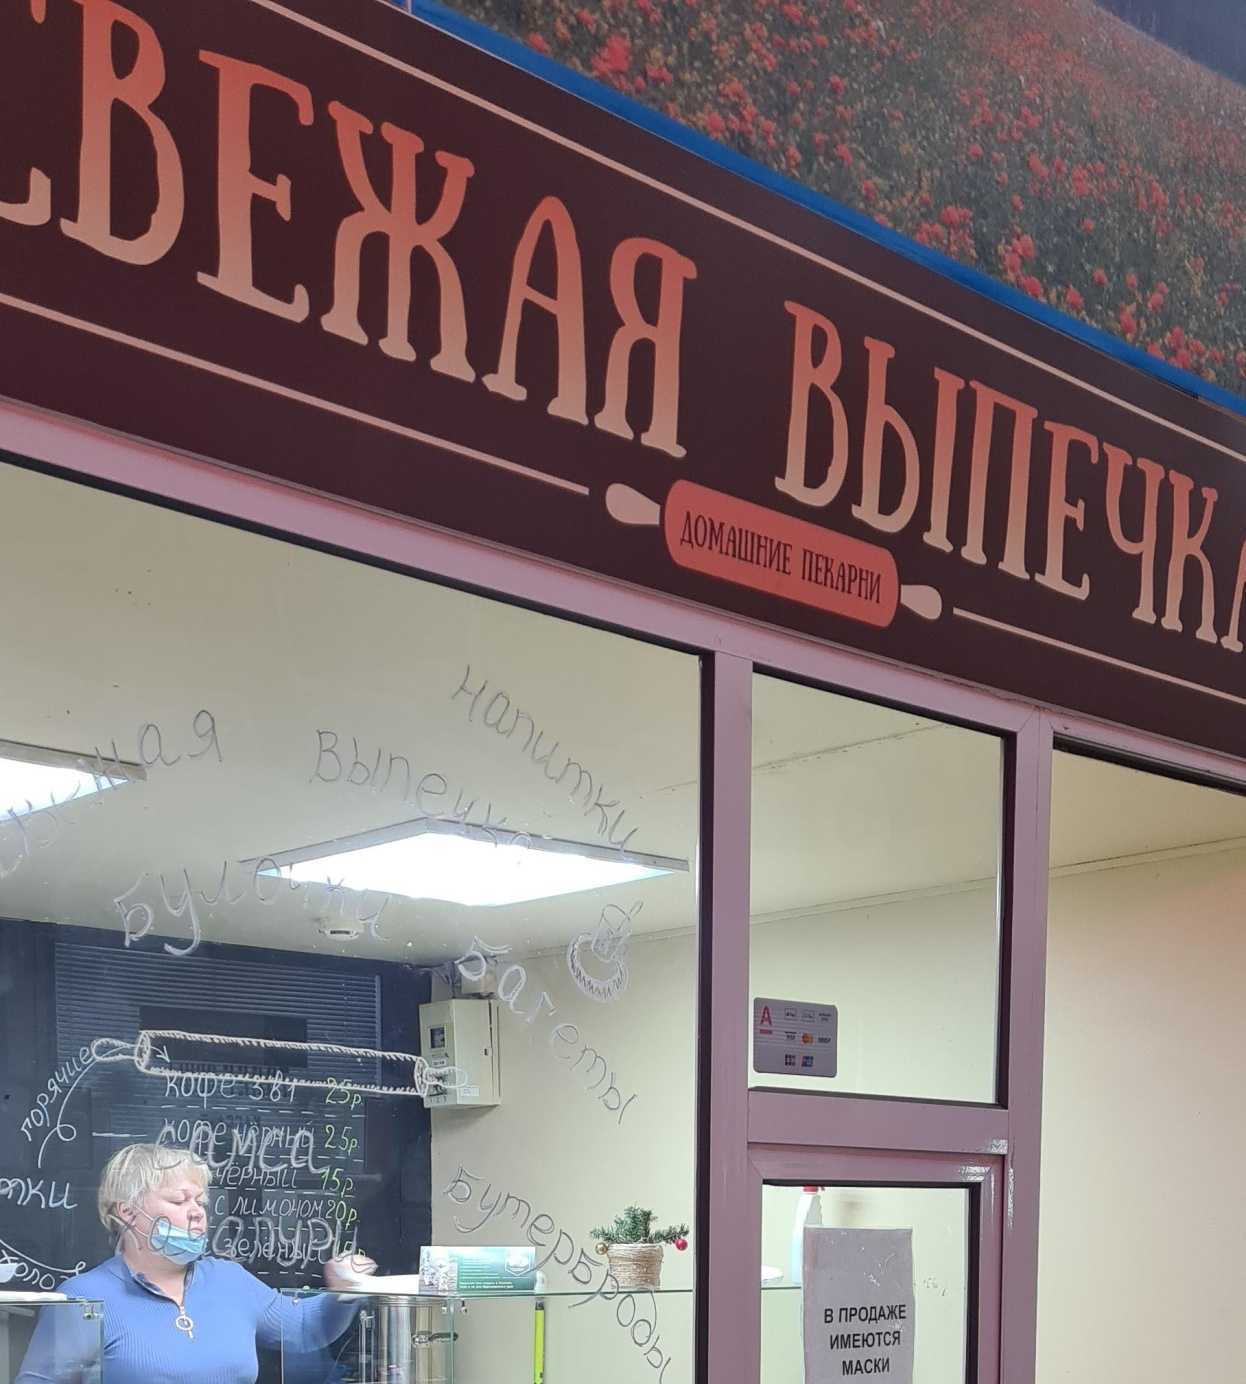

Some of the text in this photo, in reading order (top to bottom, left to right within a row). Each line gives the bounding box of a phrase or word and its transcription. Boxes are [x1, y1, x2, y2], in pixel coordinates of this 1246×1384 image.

[680, 511, 882, 604] ДОМАШНИЕ ПЕКАРНИ
[824, 1304, 907, 1324] В ПРОДАЖЕ
[830, 1331, 901, 1350] ИМЕЮТСЯ
[842, 1358, 890, 1377] МАСКИ
